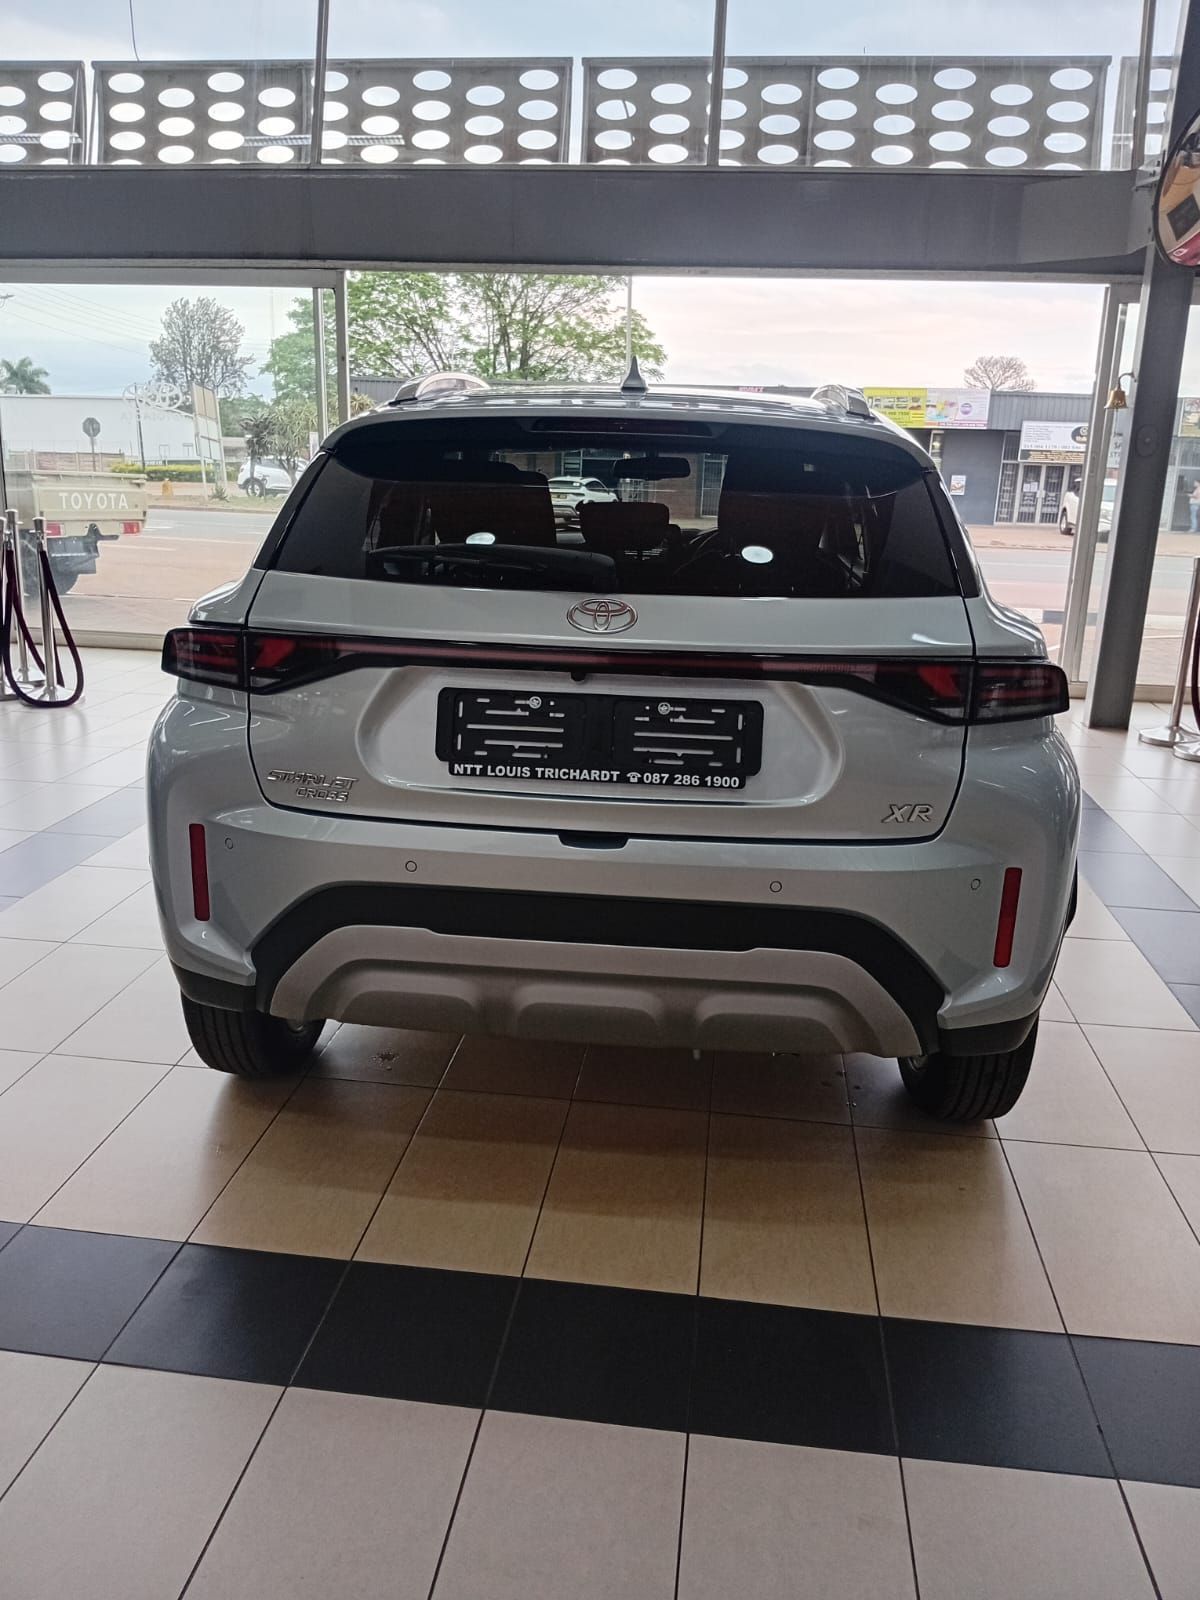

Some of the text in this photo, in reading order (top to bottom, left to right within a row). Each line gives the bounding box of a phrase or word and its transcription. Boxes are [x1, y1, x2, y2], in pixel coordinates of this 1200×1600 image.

[58, 492, 129, 509] TOYOTA
[267, 769, 359, 790] STARLET
[453, 763, 740, 788] NTT LOUIS TRICHARDT 087 286 1900
[296, 787, 349, 803] CROSS
[881, 803, 933, 823] XR
